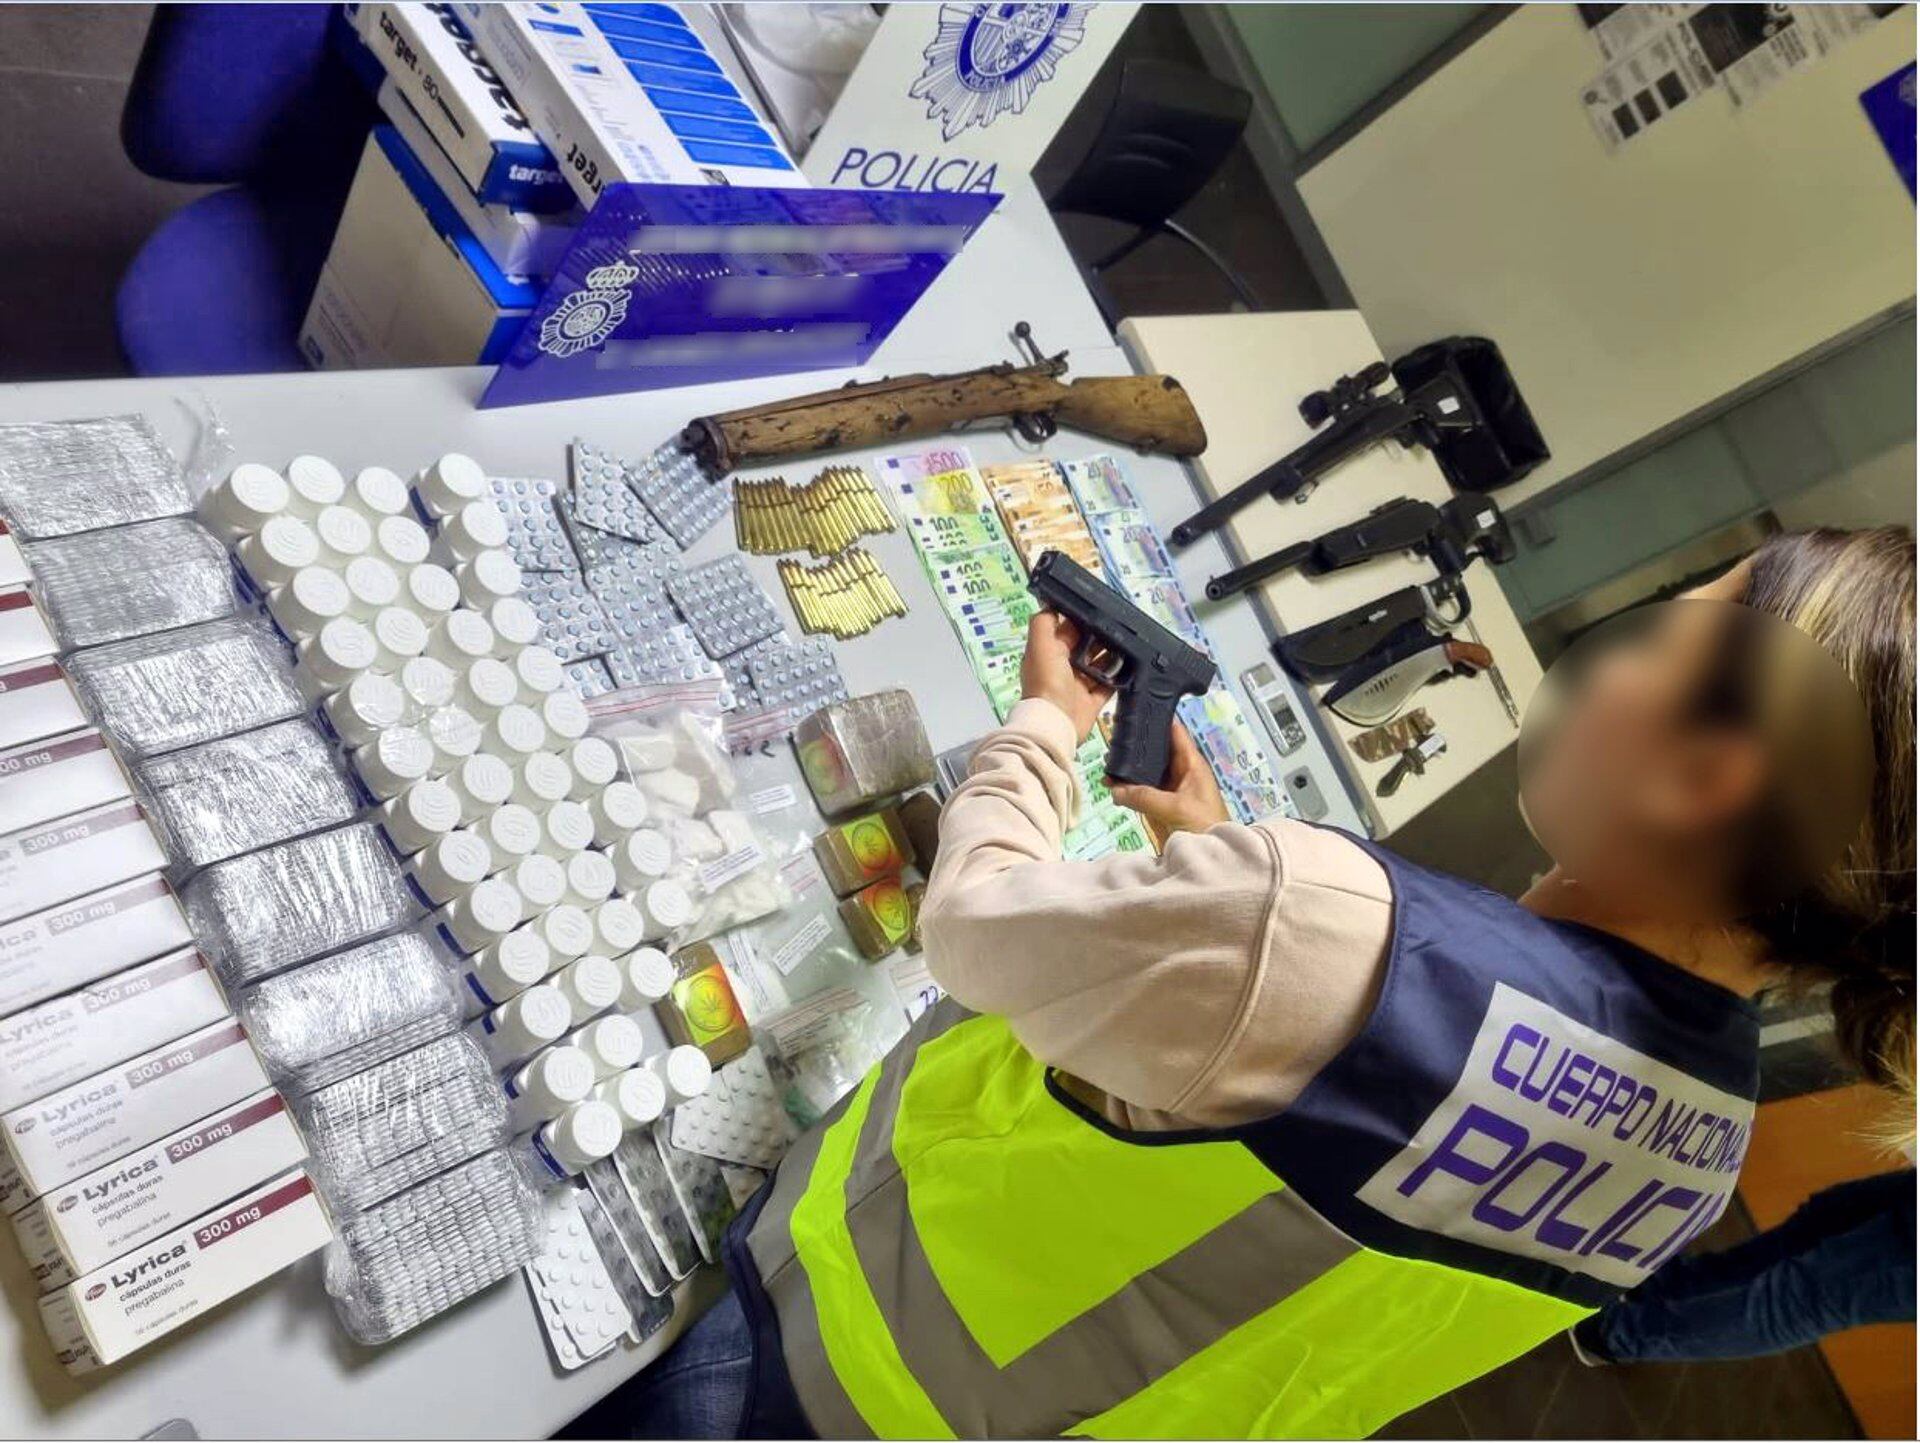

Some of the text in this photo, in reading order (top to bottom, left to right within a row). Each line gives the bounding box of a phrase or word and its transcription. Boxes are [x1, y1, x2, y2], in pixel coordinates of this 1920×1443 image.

[380, 11, 418, 71] target
[567, 143, 607, 195] rget
[831, 147, 999, 193] POLICIA
[0, 750, 52, 774] 00 mg
[62, 825, 90, 842] mg
[89, 901, 117, 918] mg
[125, 976, 152, 996] mg
[41, 1049, 195, 1123] Lyrica 300 mg
[1491, 1023, 1657, 1141] CUERPO
[82, 1123, 234, 1201] Lyrica 300 mg
[111, 1244, 187, 1289] Lyrica
[199, 1219, 232, 1244] 300
[235, 1206, 262, 1228] mg
[124, 1278, 185, 1317] pregabalina
